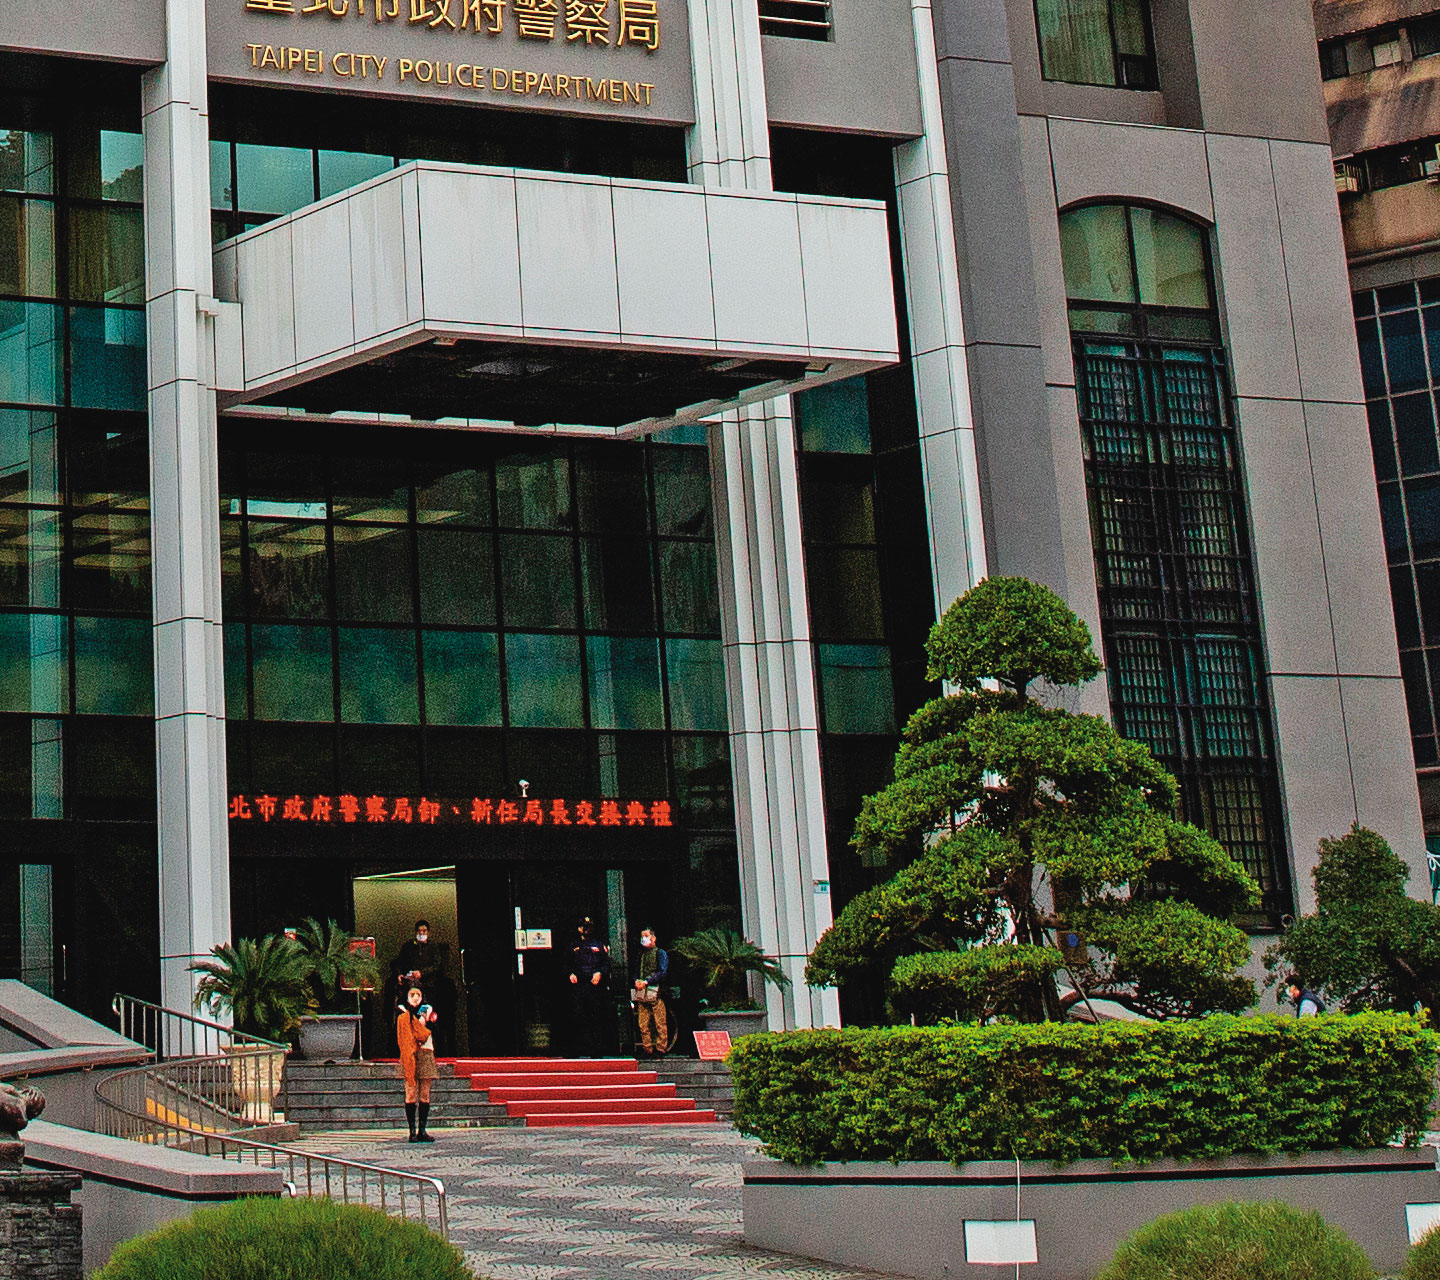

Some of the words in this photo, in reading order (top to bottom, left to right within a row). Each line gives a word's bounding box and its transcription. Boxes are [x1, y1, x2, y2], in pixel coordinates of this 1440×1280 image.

[247, 42, 324, 74] TAIPEI
[332, 51, 388, 79] CITY
[399, 57, 485, 90] POLICE
[490, 67, 655, 107] DEPARTMENT
